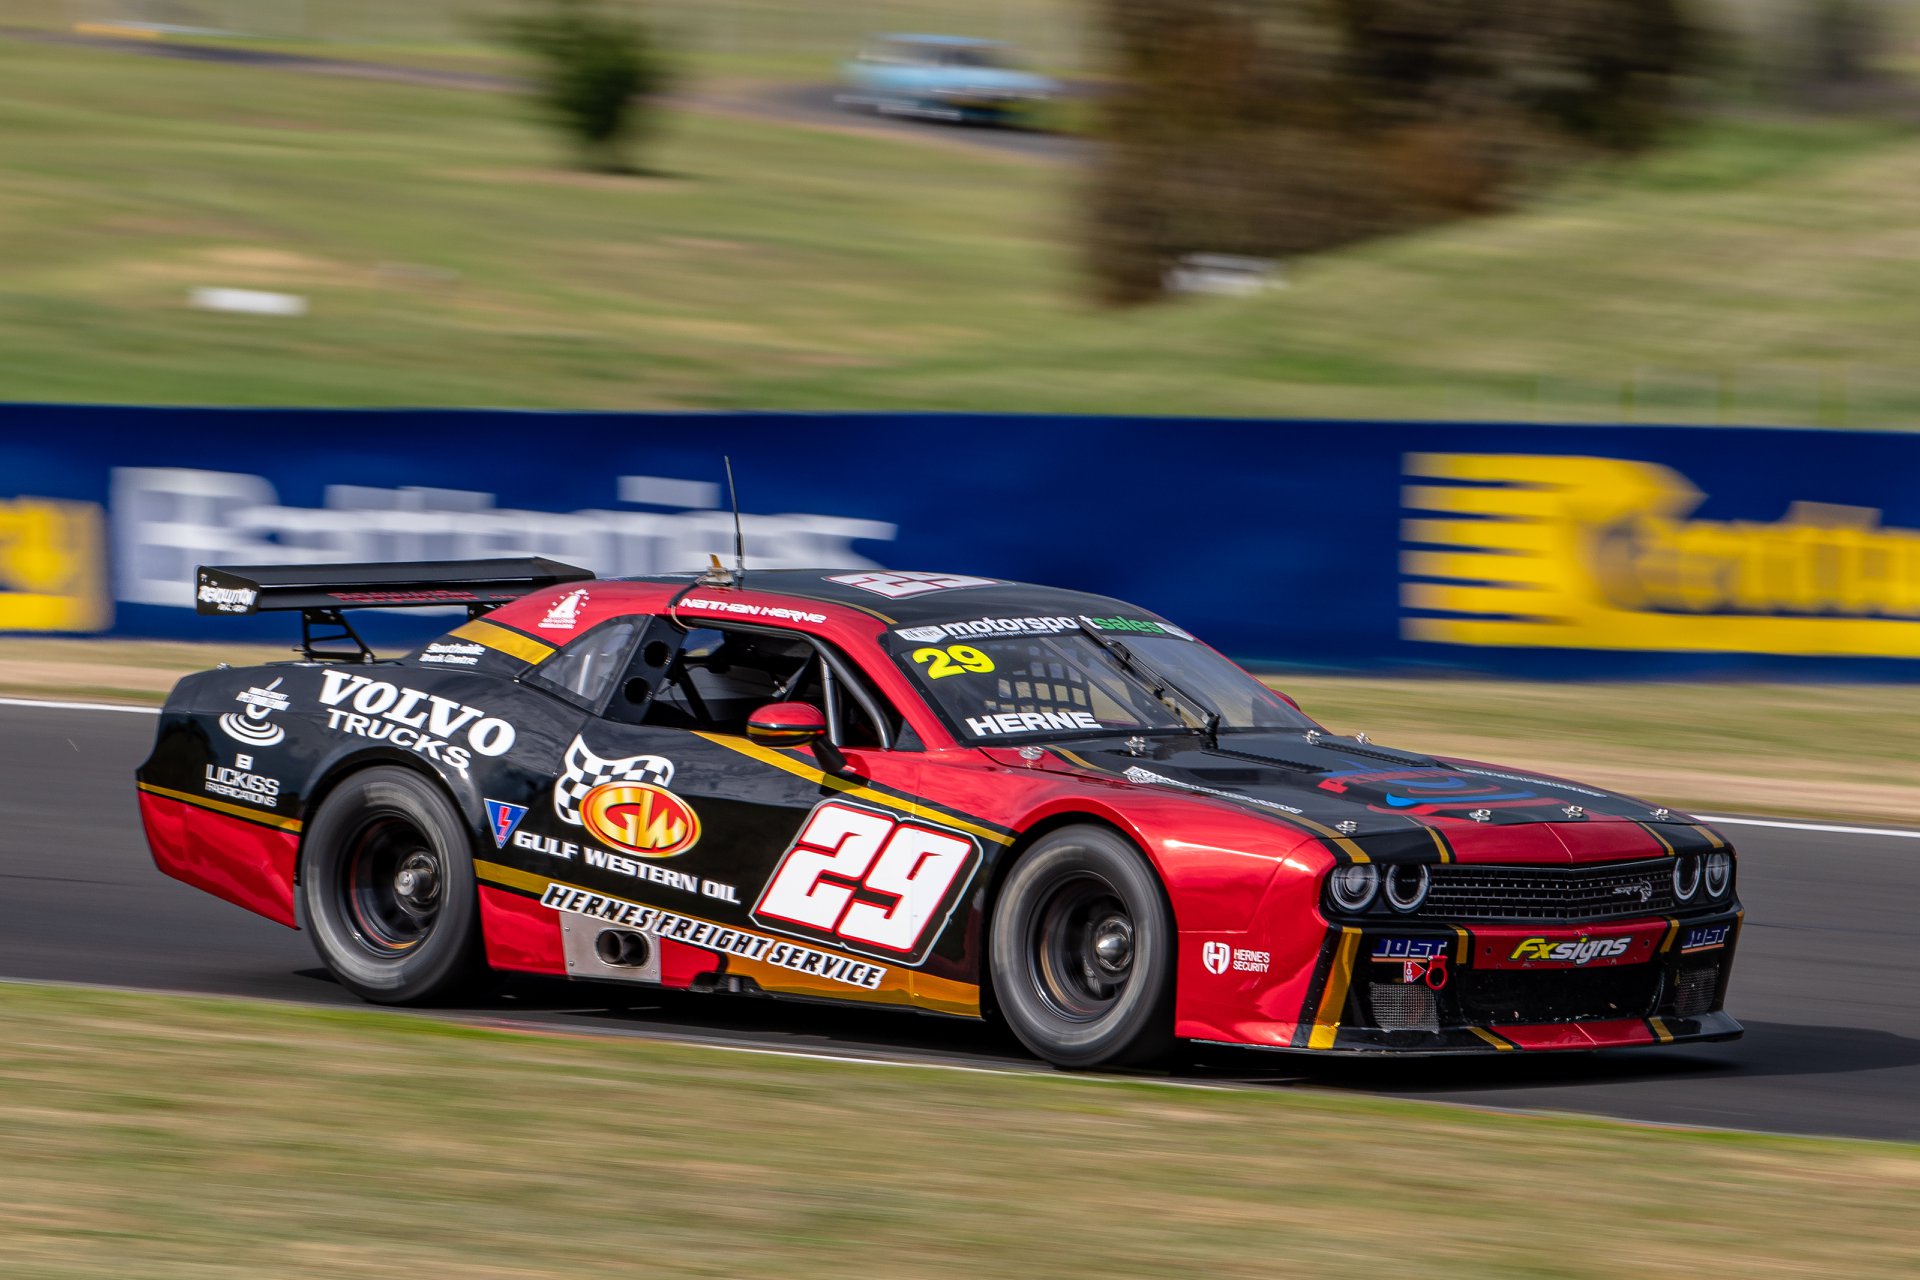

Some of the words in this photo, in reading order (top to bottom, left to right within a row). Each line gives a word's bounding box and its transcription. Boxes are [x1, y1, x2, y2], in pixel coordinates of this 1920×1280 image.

[940, 615, 1166, 634] motorspotsales
[912, 645, 995, 679] 29
[319, 669, 516, 757] VOLVO
[965, 712, 1103, 736] HERNE
[326, 708, 471, 769] TRUCKS
[205, 763, 280, 796] LICKISS
[591, 788, 688, 850] GW
[513, 830, 579, 861] GULF
[583, 846, 699, 894] WESTERN
[702, 878, 742, 905] OIL
[755, 803, 973, 953] 29
[769, 942, 885, 988] SERVICE
[1232, 960, 1270, 973] SECURITY
[1233, 948, 1271, 963] HERNE'S
